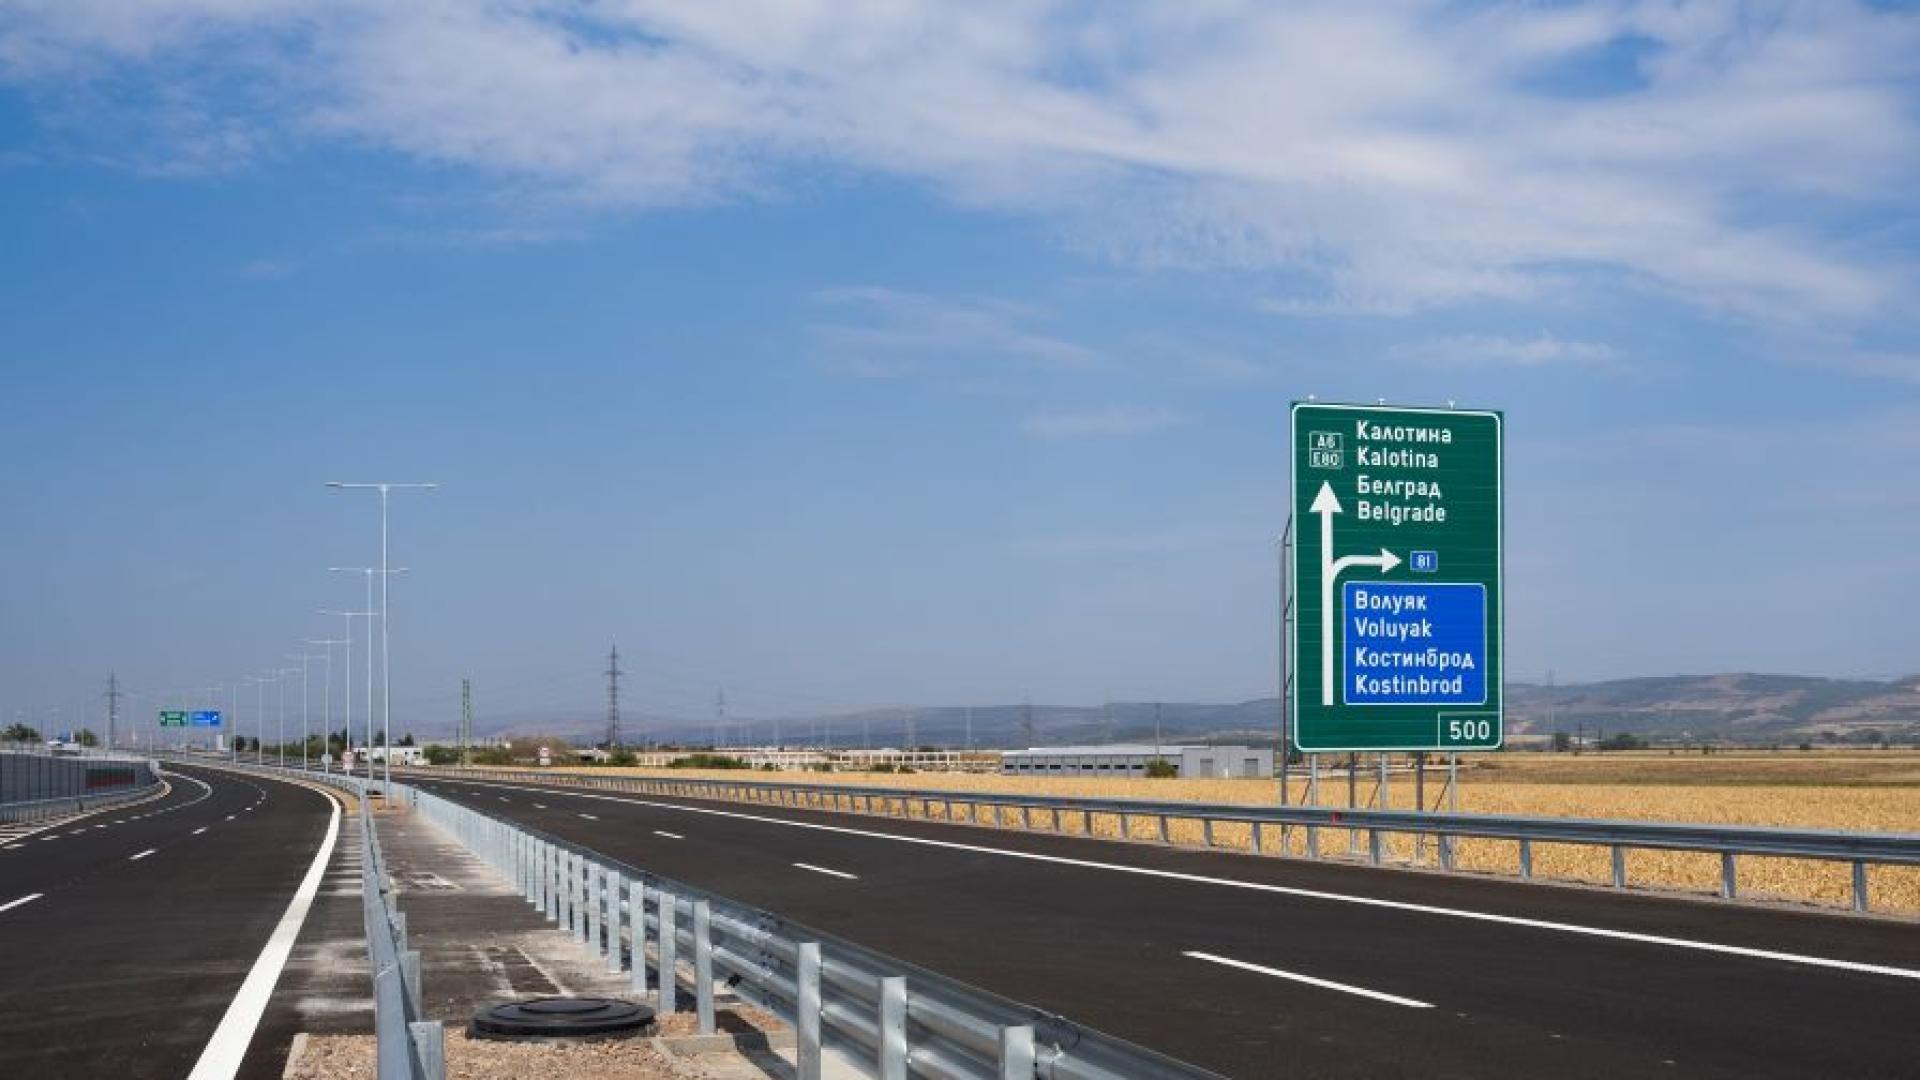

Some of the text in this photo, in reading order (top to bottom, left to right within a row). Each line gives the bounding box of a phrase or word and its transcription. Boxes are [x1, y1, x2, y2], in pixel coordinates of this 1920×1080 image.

[1317, 434, 1335, 449] A6
[1356, 420, 1452, 443] Калотина
[1313, 452, 1338, 466] E80
[1357, 446, 1438, 468] Kalotina
[1357, 475, 1441, 500] Белград
[1357, 501, 1446, 525] Belgrade
[1417, 554, 1430, 568] 81
[1354, 590, 1427, 615] Волуяк
[1354, 616, 1432, 642] Voluyak
[1355, 647, 1475, 671] Костинброд
[1355, 674, 1463, 695] Kostinbrod
[1449, 720, 1490, 740] 500
